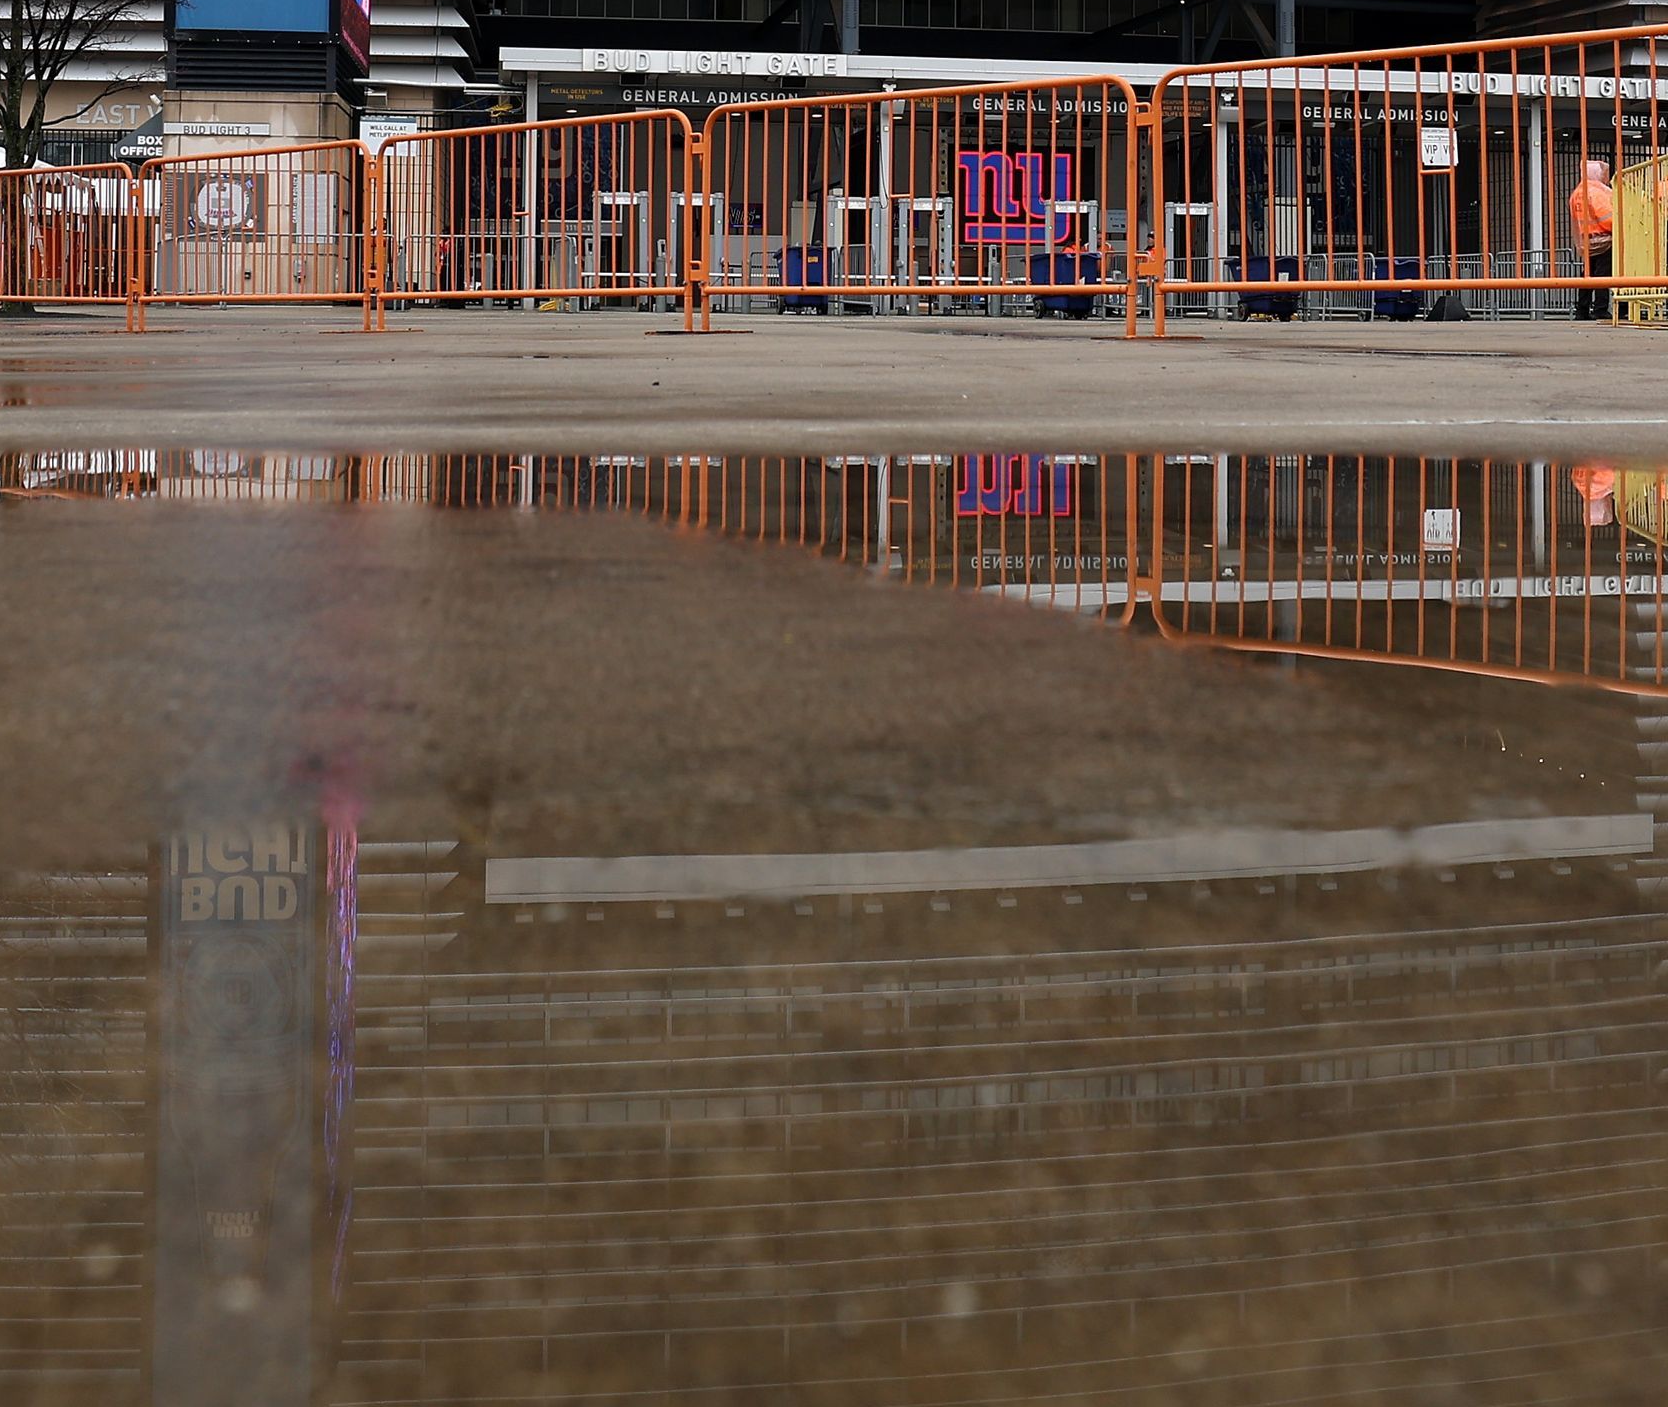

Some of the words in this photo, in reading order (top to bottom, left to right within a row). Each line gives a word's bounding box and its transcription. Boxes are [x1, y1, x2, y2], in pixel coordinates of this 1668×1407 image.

[593, 50, 652, 72] BUD
[666, 51, 752, 74] LIGHT
[766, 54, 838, 76] GATE
[1451, 73, 1500, 94] BUD
[622, 89, 700, 104] GENERAL
[706, 92, 799, 105] ADMISSION
[972, 97, 1047, 112] GENERAL
[75, 104, 141, 125] EAST
[1303, 106, 1373, 120] GENERAL
[183, 125, 207, 135] BUD
[208, 125, 241, 136] LIGHT
[244, 126, 252, 135] 3
[136, 135, 164, 146] BOX
[119, 146, 164, 157] OFFICE
[1423, 144, 1439, 155] VIP
[958, 150, 1072, 244] ny
